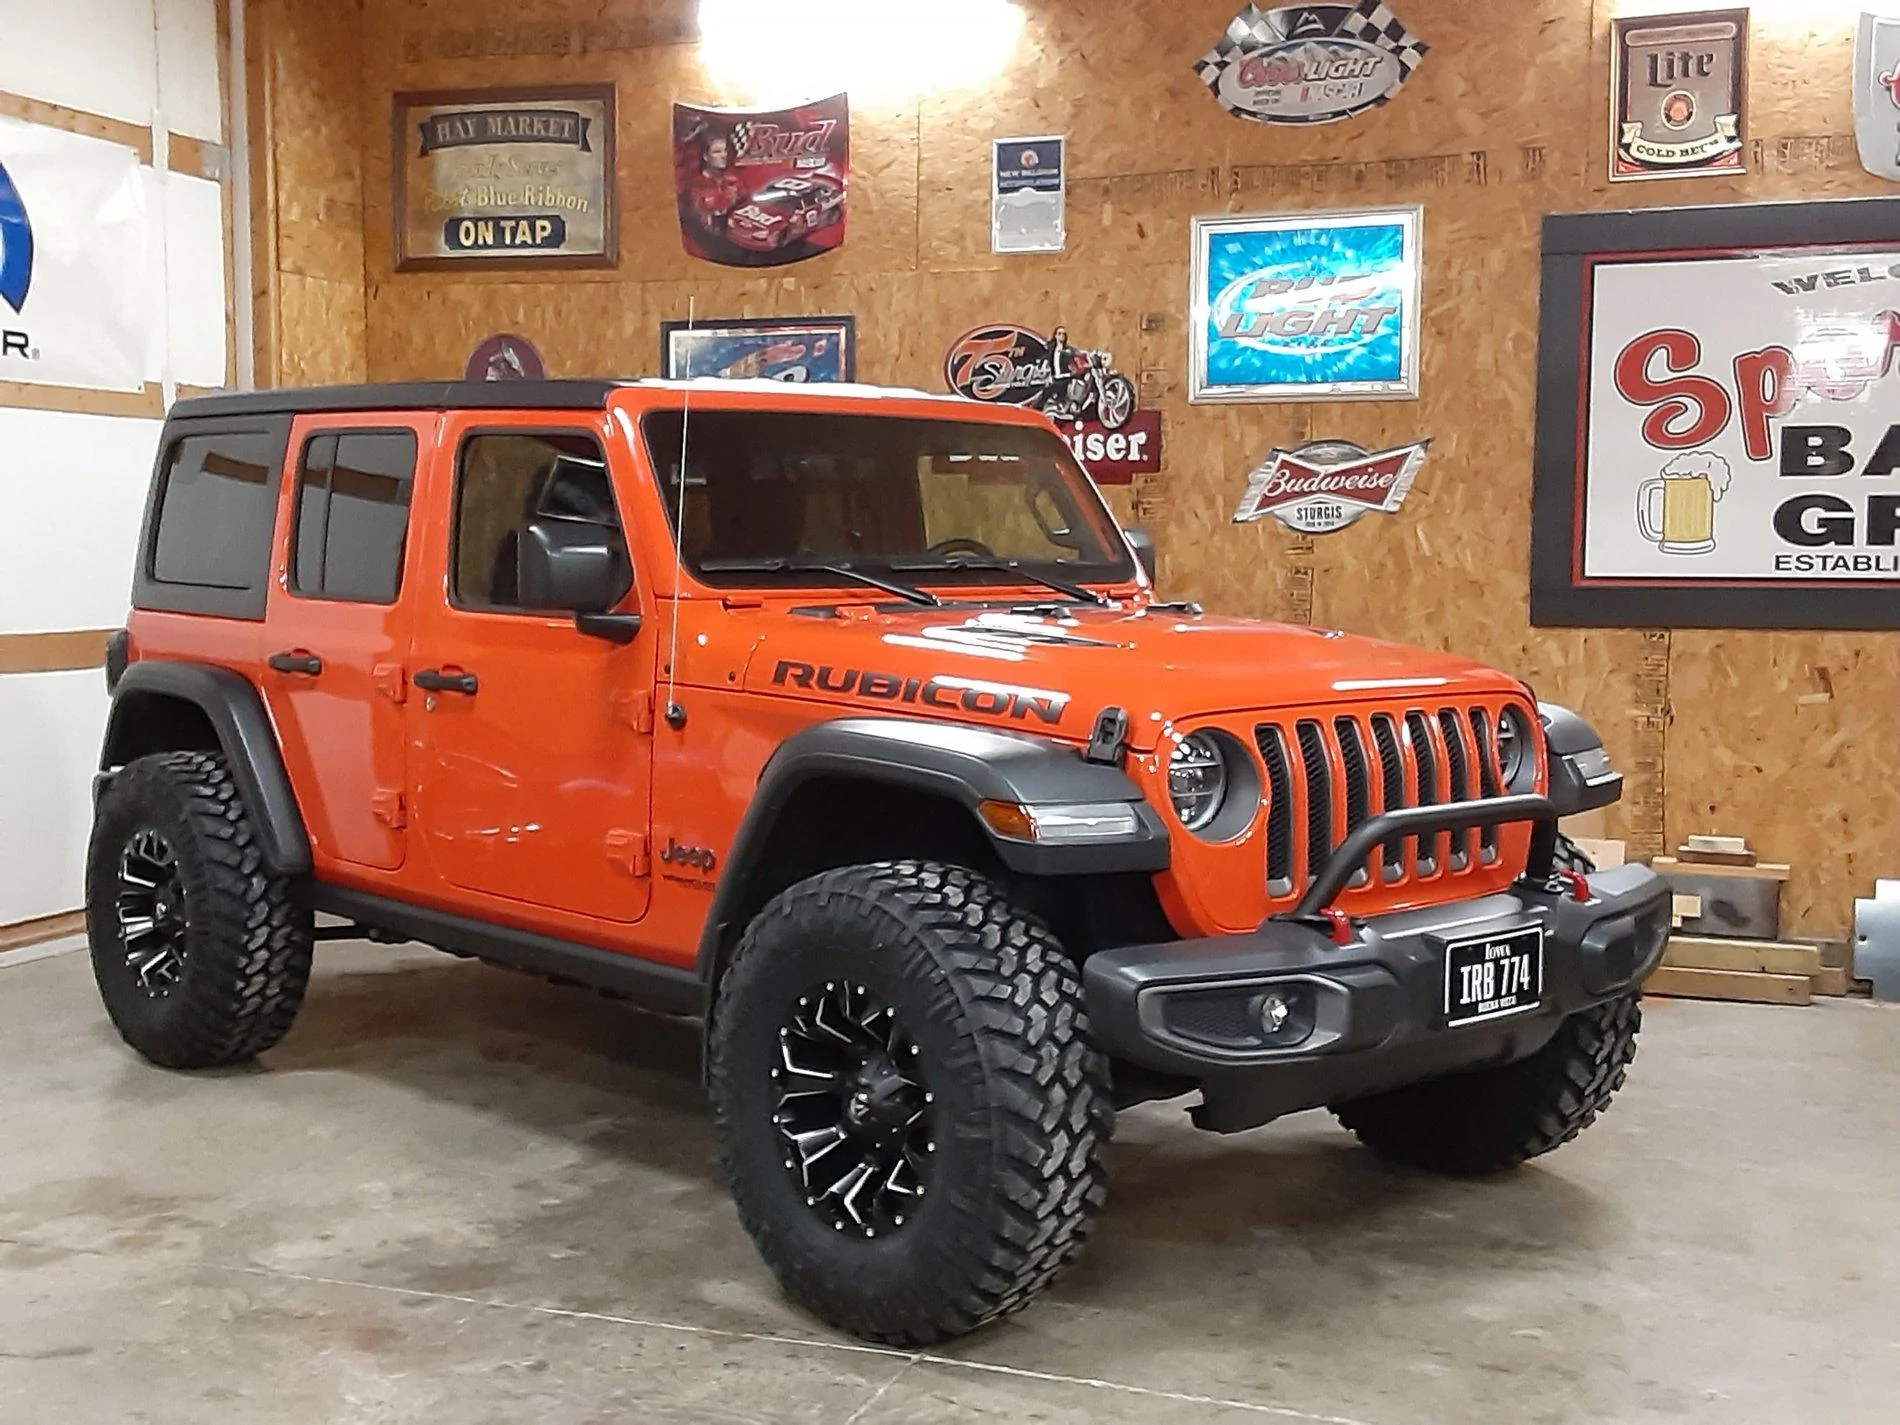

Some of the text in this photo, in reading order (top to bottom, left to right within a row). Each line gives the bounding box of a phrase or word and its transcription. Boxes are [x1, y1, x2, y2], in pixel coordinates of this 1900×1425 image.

[1303, 57, 1383, 81] LIGHT
[1647, 50, 1714, 88] Lite
[437, 116, 573, 143] HAY MARKET
[747, 120, 837, 157] Bud
[1636, 139, 1718, 158] COLD BE
[475, 184, 518, 207] Blue
[524, 183, 588, 213] Ribbon
[458, 219, 552, 246] ON TAP
[1220, 306, 1397, 339] LIGHT
[1296, 506, 1342, 521] STURGIS
[771, 660, 1071, 726] RUBICON
[660, 837, 717, 875] Jeep
[1500, 953, 1530, 996] 774
